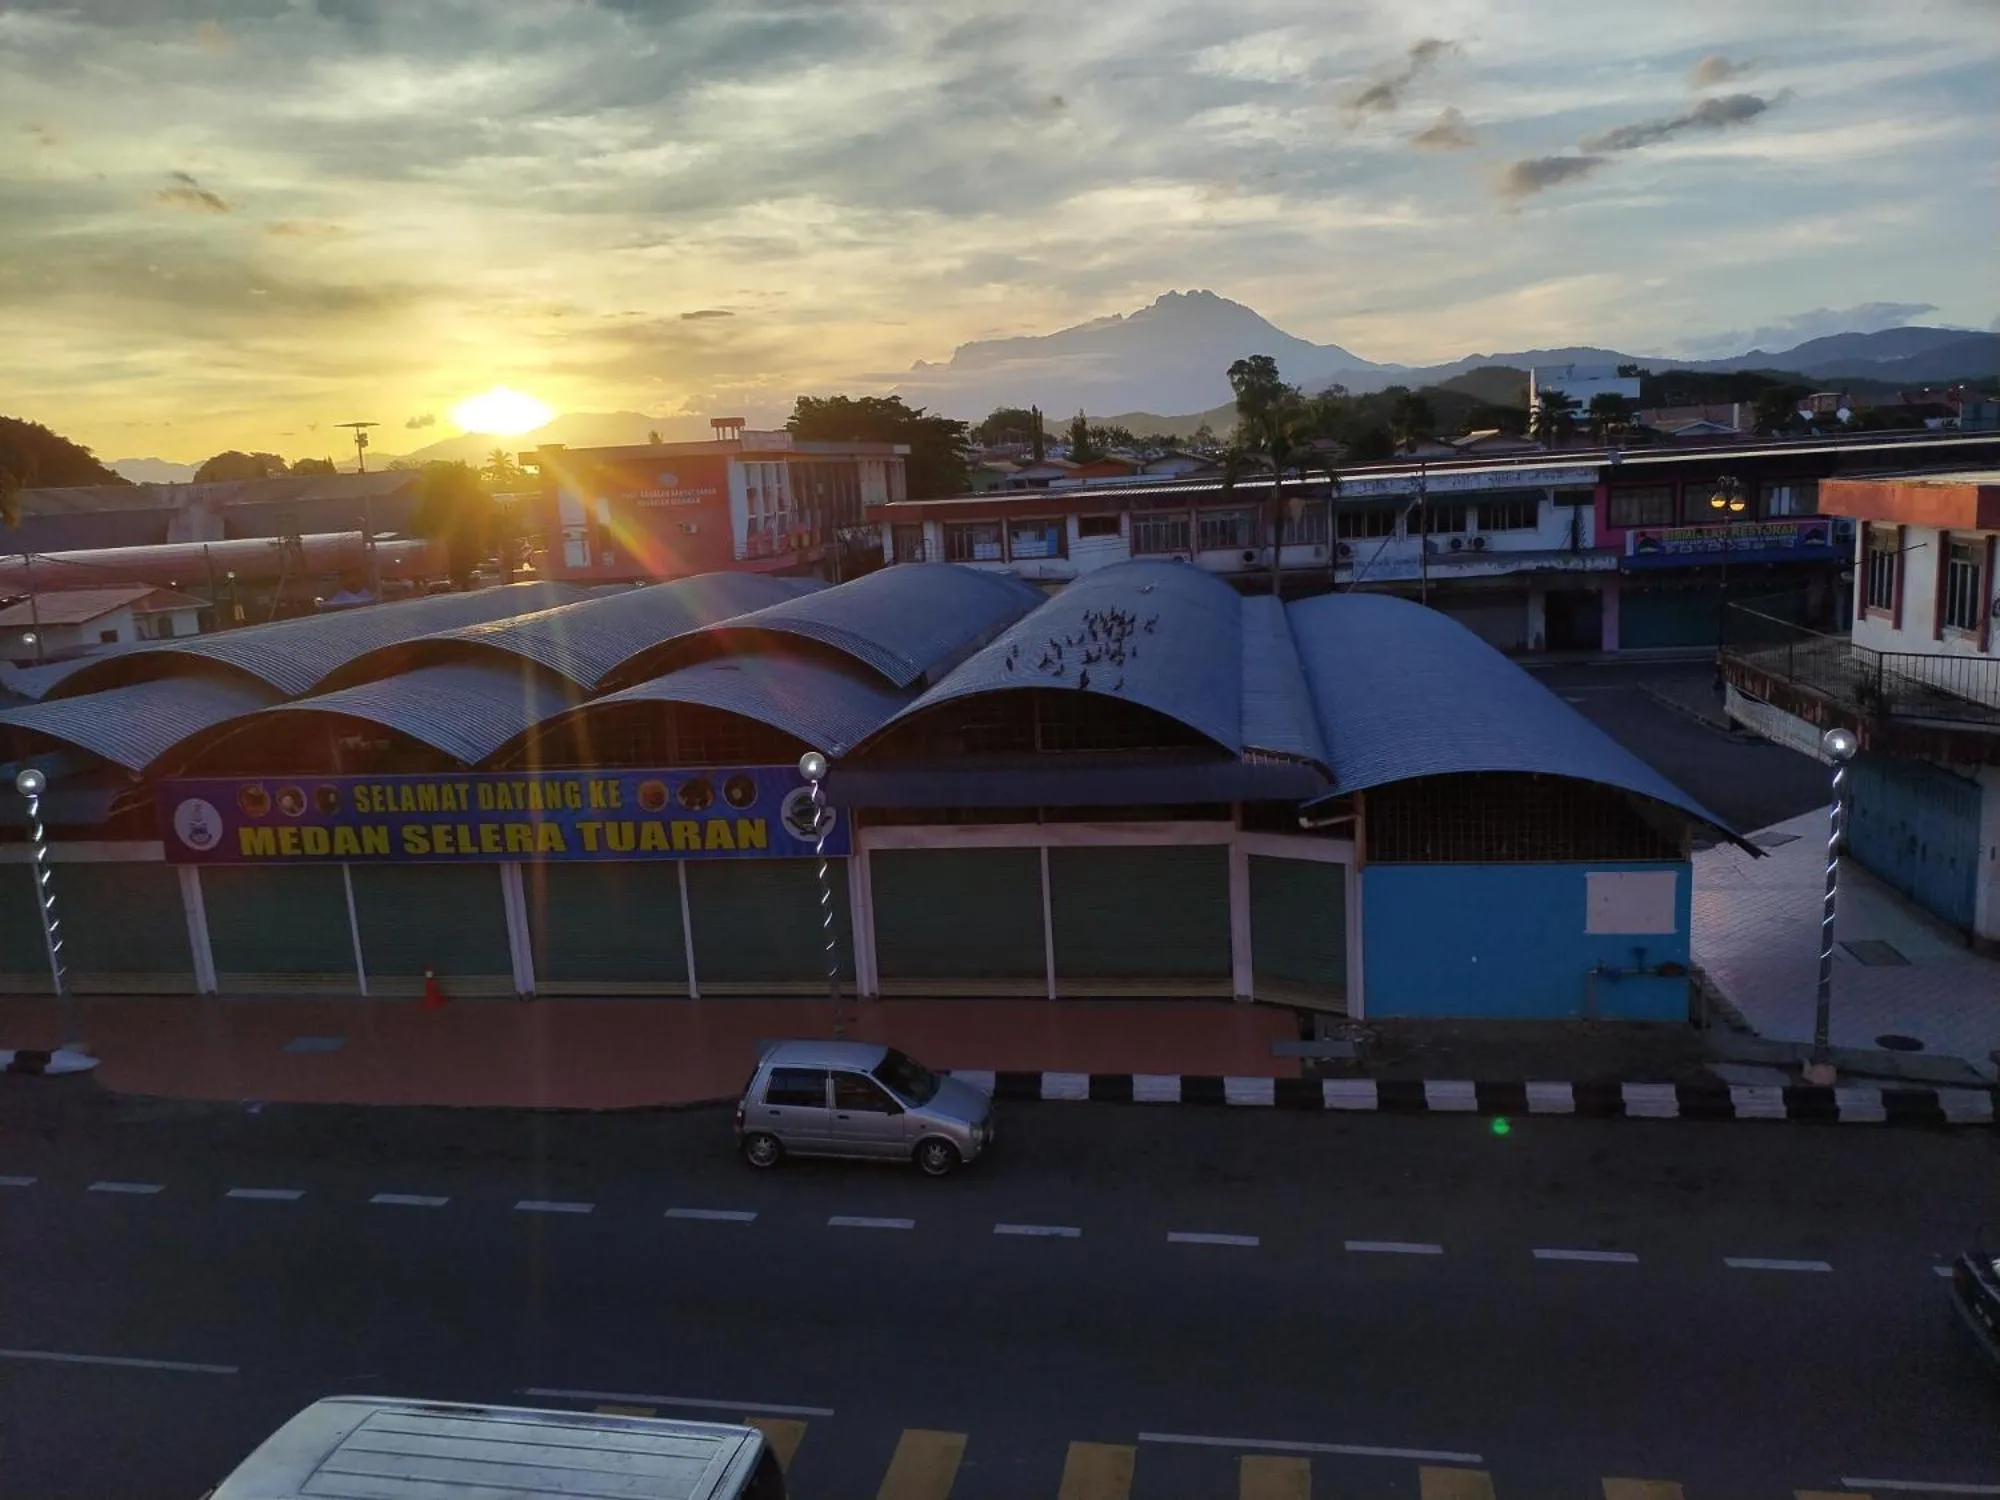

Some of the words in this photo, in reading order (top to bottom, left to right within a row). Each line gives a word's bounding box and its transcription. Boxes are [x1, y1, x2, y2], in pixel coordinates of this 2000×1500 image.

[353, 784, 470, 812] SELAMAT
[477, 780, 580, 811] DATANG
[588, 780, 623, 809] KE
[238, 824, 391, 856] MEDAN
[402, 821, 566, 854] SELERA
[576, 818, 769, 852] TUARAN
